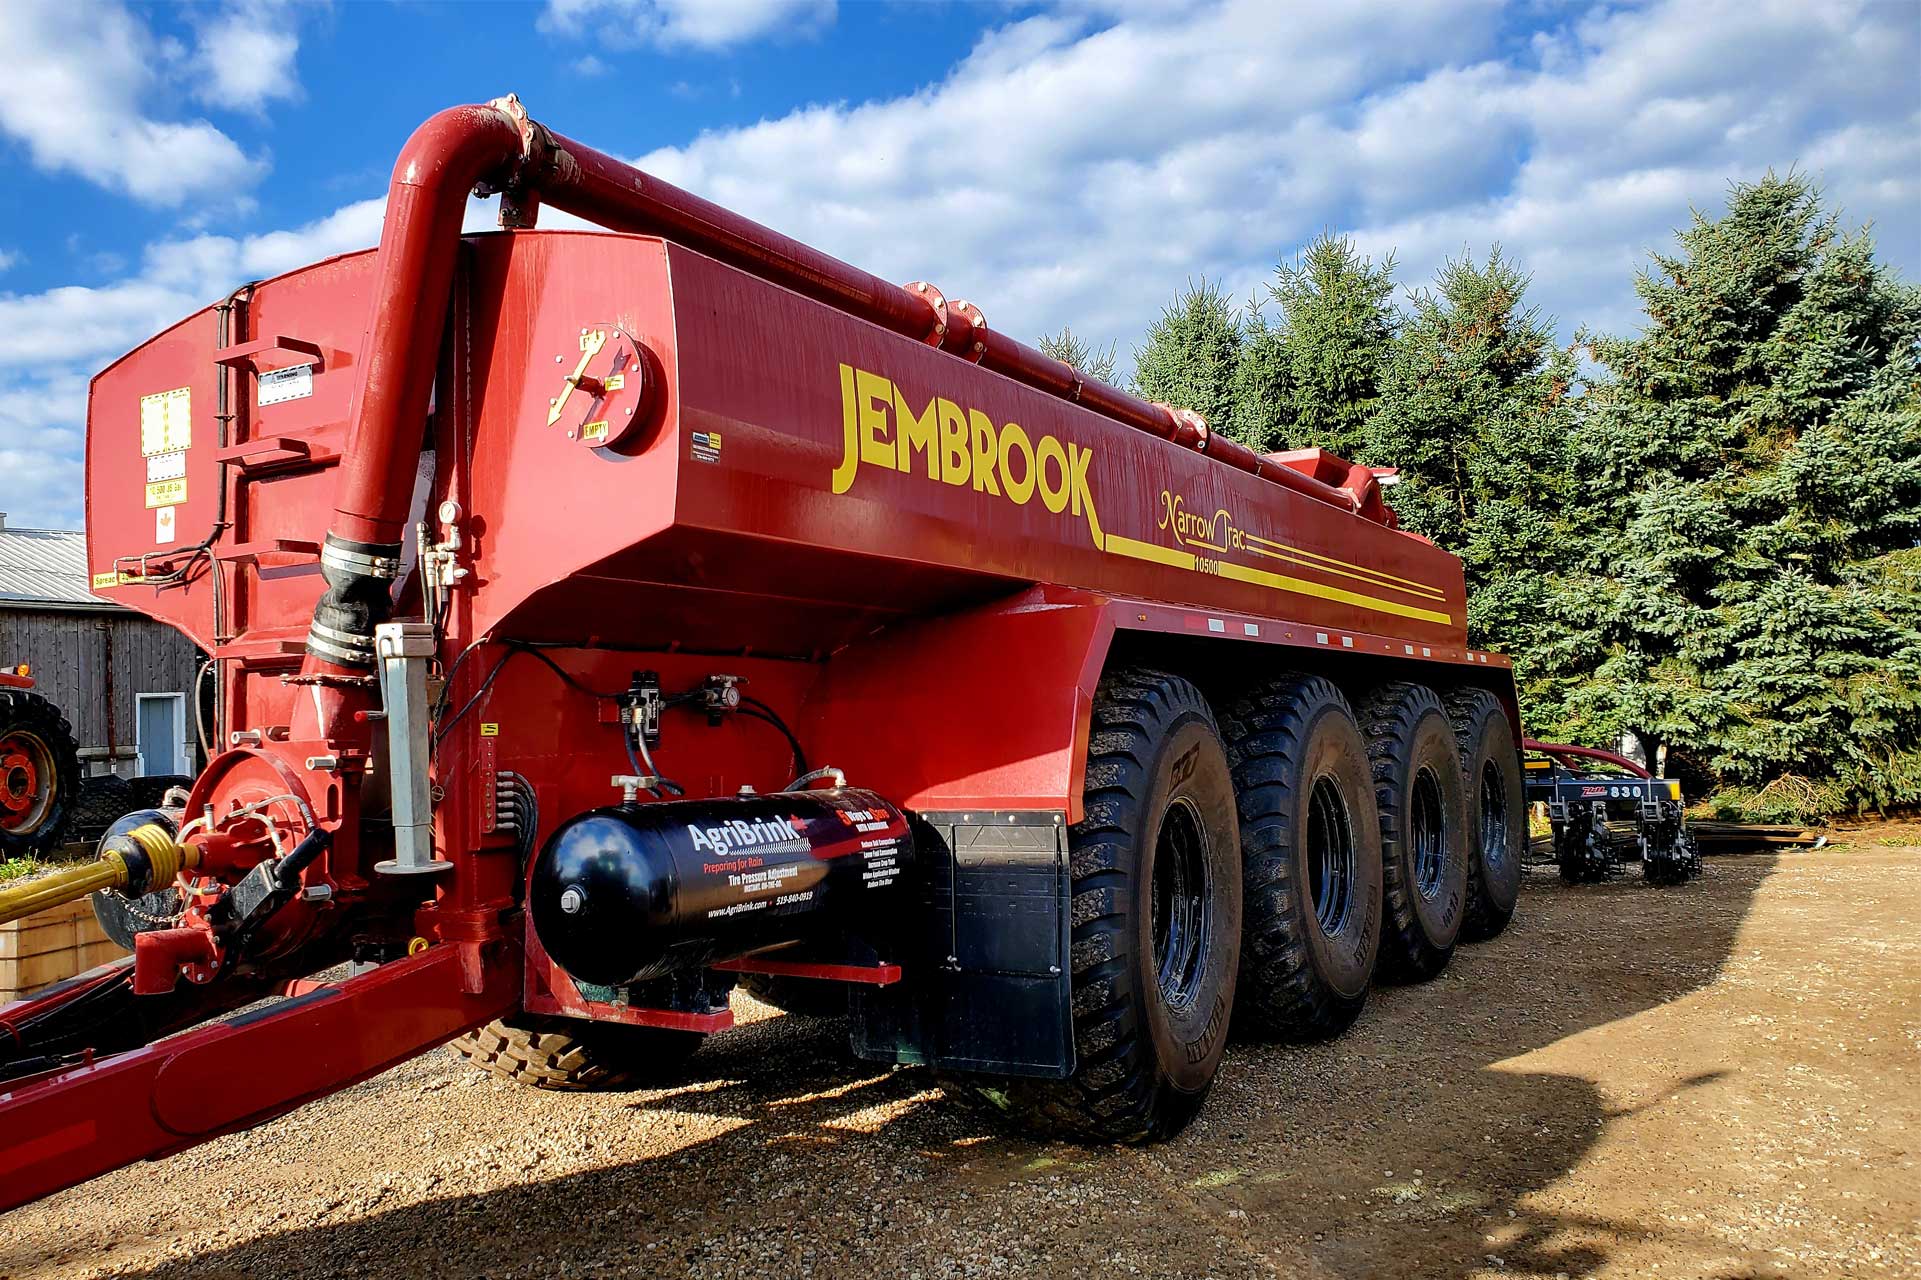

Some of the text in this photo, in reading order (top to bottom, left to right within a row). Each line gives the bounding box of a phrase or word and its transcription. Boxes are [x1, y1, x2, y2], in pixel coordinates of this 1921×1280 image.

[585, 423, 607, 438] EMPTY
[831, 362, 1104, 551] JEMBROOK
[1157, 490, 1216, 546] Narrow
[1194, 556, 1219, 576] 10500
[835, 809, 852, 826] 5
[687, 814, 801, 856] AgriBrink
[703, 857, 763, 874] Preparing for Rain
[728, 866, 798, 887] Tire Pressure Adjustment
[708, 900, 768, 918] www.AgriBrink.com
